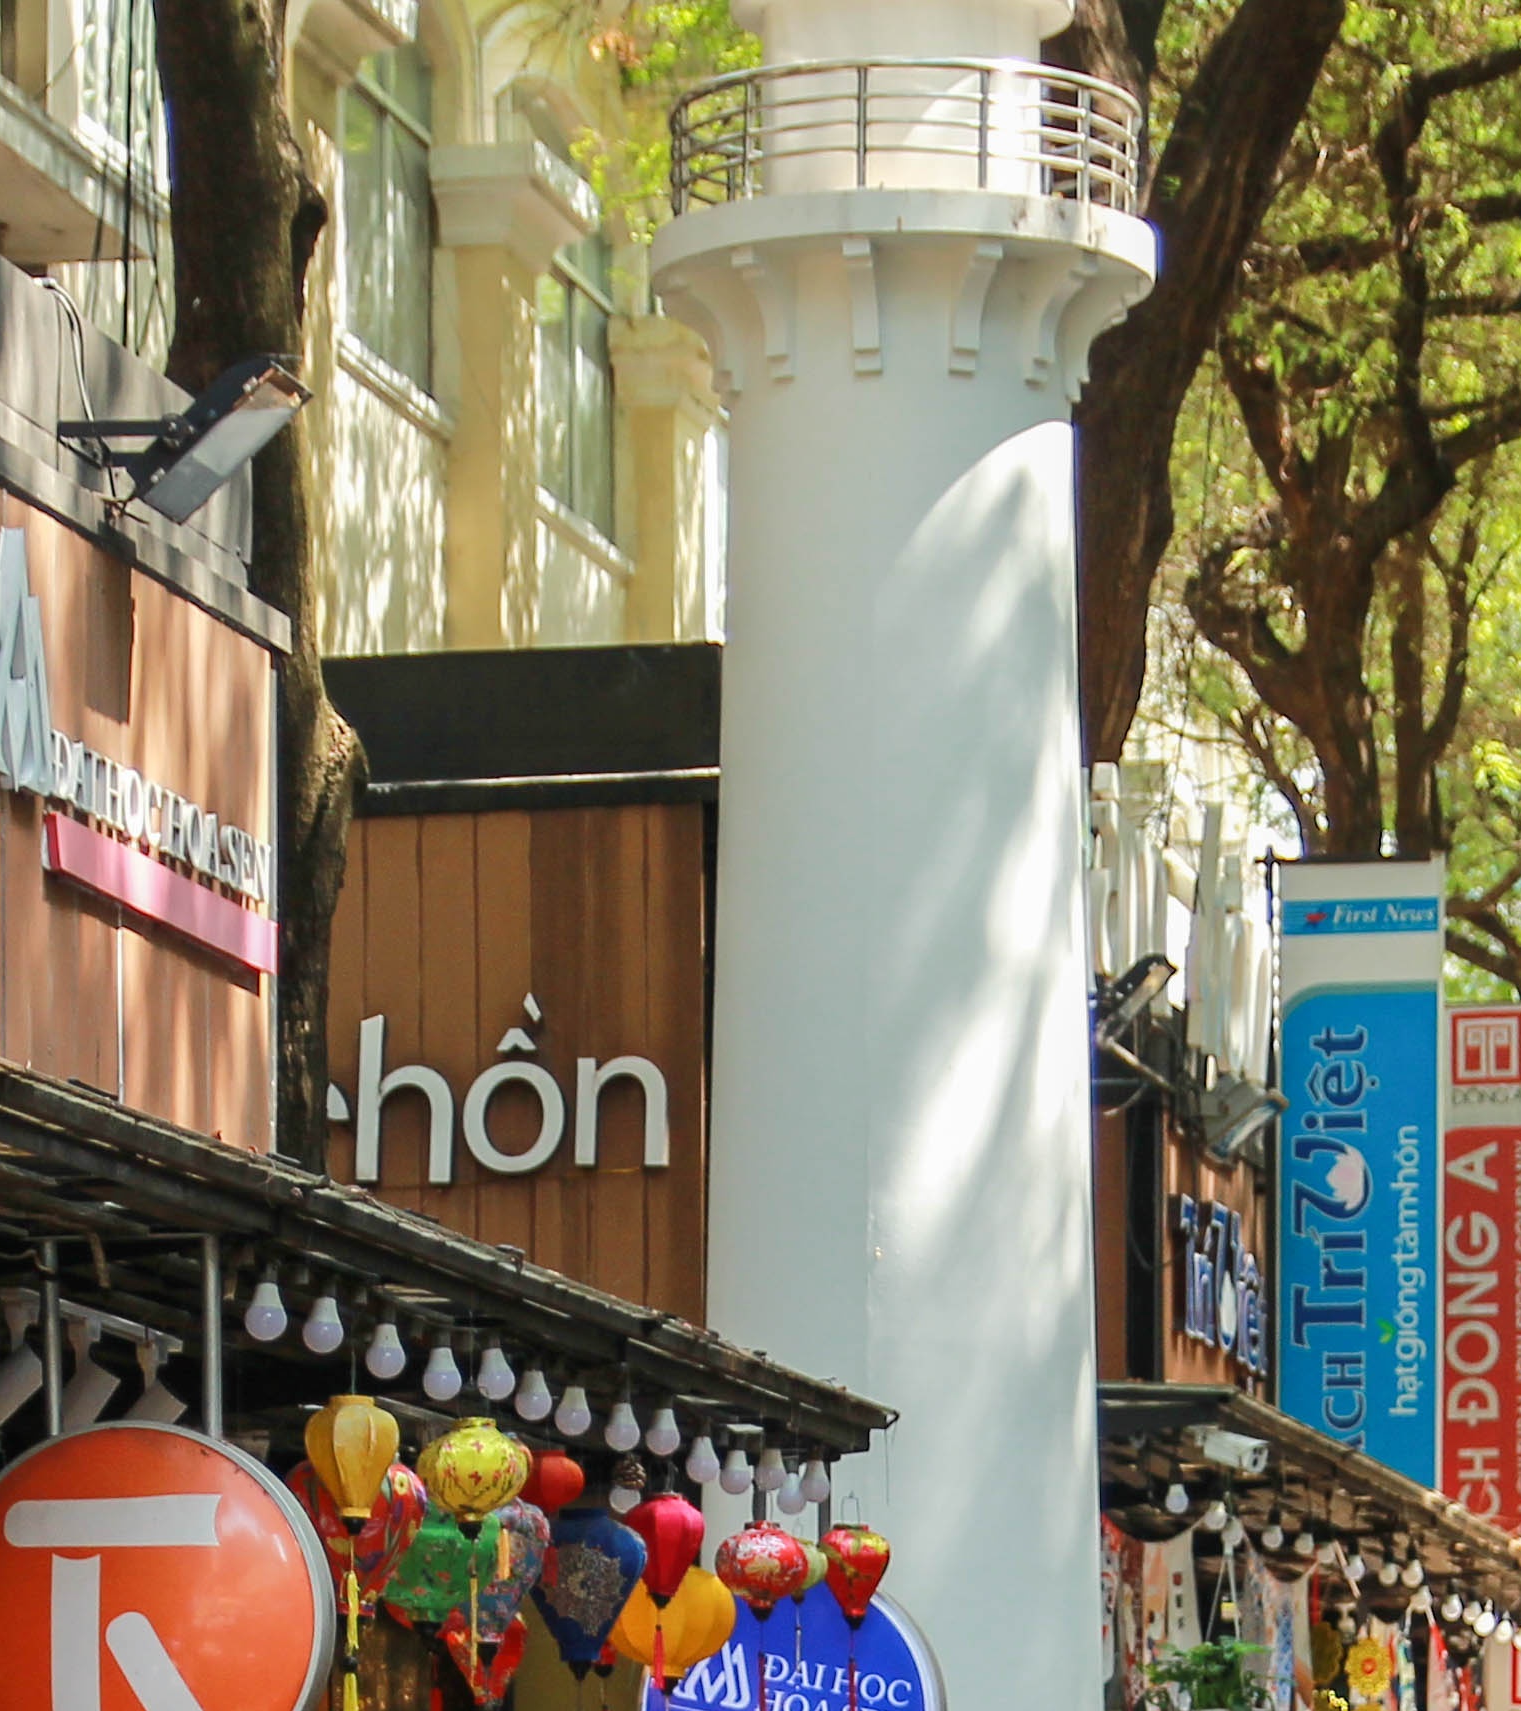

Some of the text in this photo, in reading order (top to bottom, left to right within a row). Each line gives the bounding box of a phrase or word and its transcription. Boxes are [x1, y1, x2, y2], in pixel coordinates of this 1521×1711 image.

[220, 822, 272, 904] SEN
[1332, 902, 1435, 925] First News
[327, 991, 670, 1185] hồn
[1446, 1141, 1500, 1192] A
